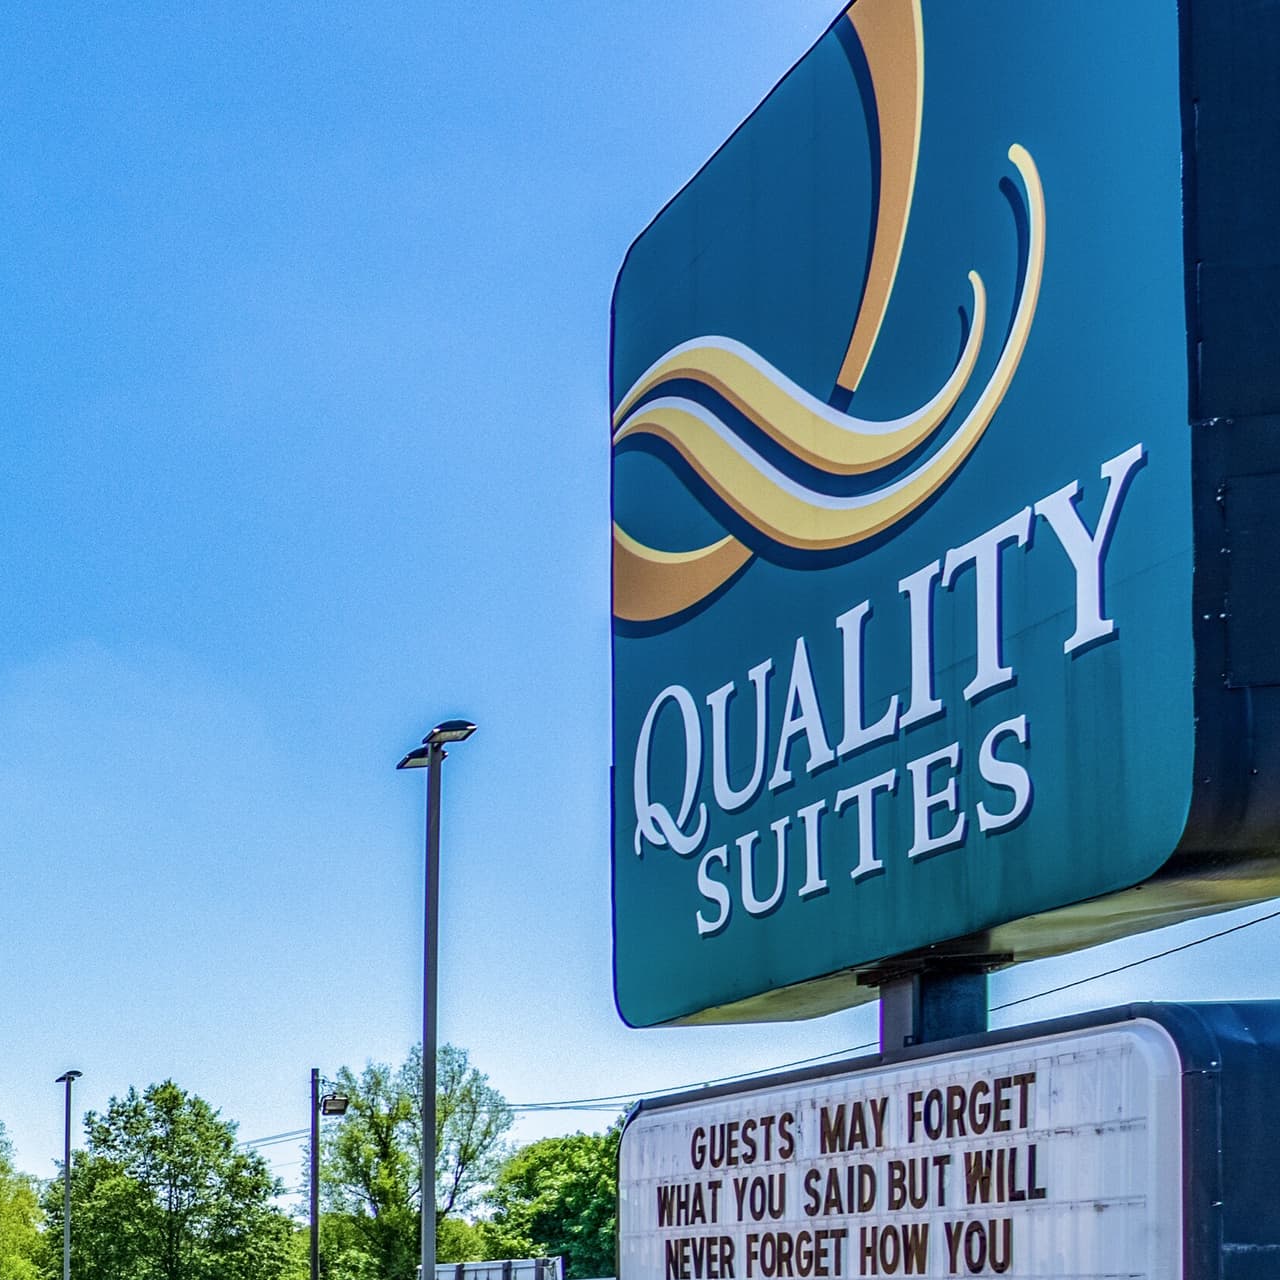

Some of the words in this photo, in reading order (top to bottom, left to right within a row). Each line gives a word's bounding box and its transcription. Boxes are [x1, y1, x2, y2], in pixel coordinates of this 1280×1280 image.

[633, 442, 1145, 856] QUALITY
[696, 714, 1033, 937] SUITES
[690, 1110, 795, 1171] GUESTS
[820, 1096, 891, 1154] MAY
[906, 1071, 1037, 1142] FORGET
[657, 1180, 722, 1229] WHAT
[733, 1173, 787, 1222] YOU
[803, 1163, 877, 1217] SAID
[887, 1154, 952, 1212] BUT
[964, 1144, 1047, 1204] WILL
[665, 1236, 735, 1280] NEVER
[745, 1228, 847, 1278] FORGET
[860, 1223, 930, 1276] HOW
[943, 1218, 1013, 1274] YOU
